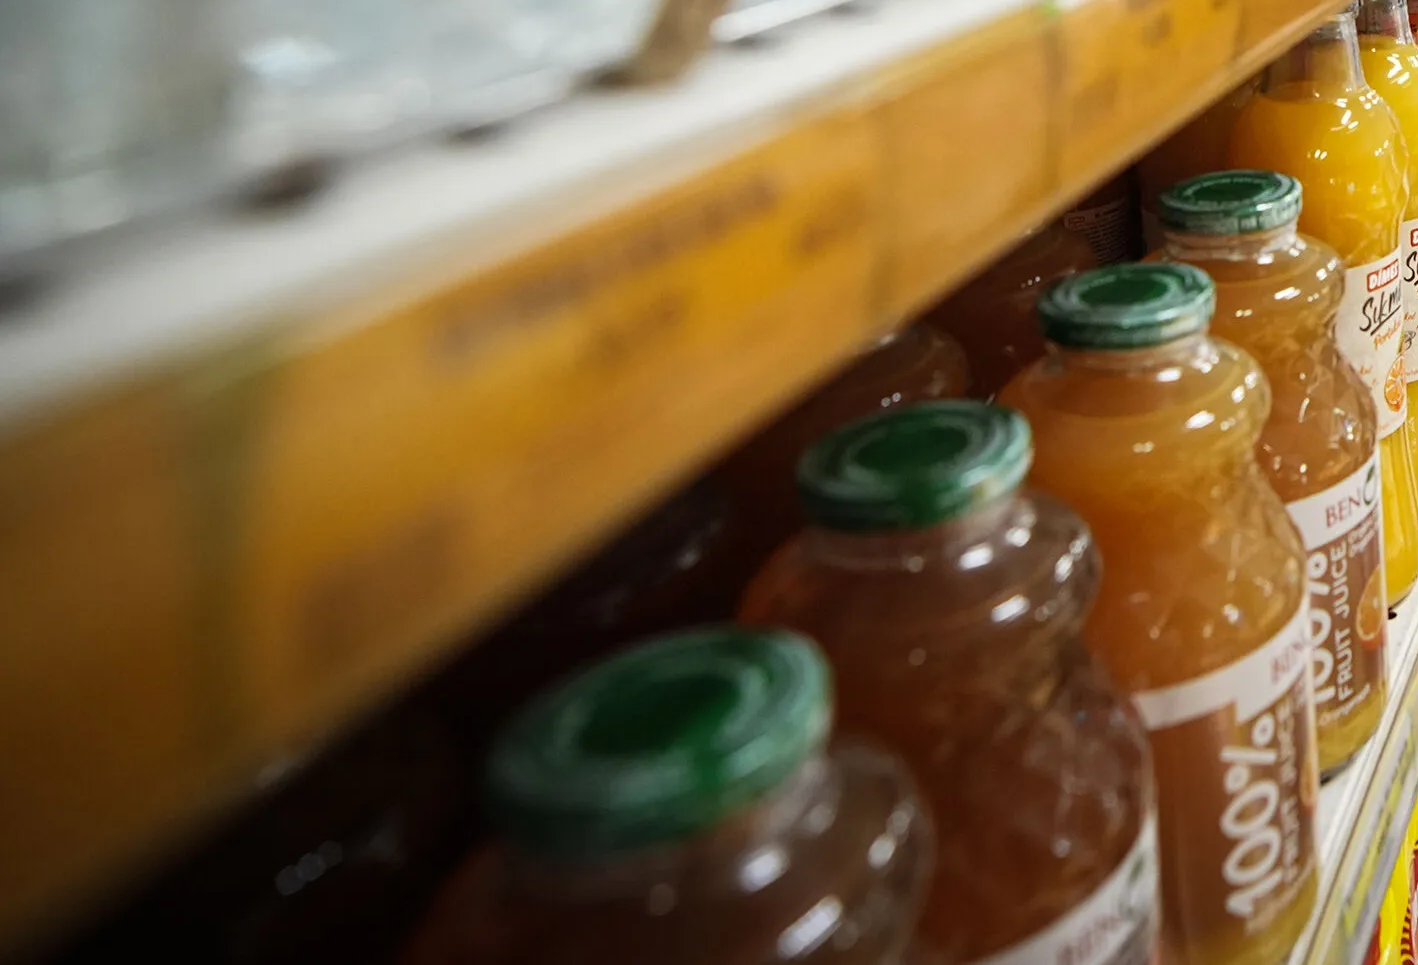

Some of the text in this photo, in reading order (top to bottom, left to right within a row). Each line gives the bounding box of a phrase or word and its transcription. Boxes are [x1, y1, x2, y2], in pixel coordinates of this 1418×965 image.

[1330, 538, 1353, 701] FRUIT JUICE
[1220, 712, 1283, 916] 100%
